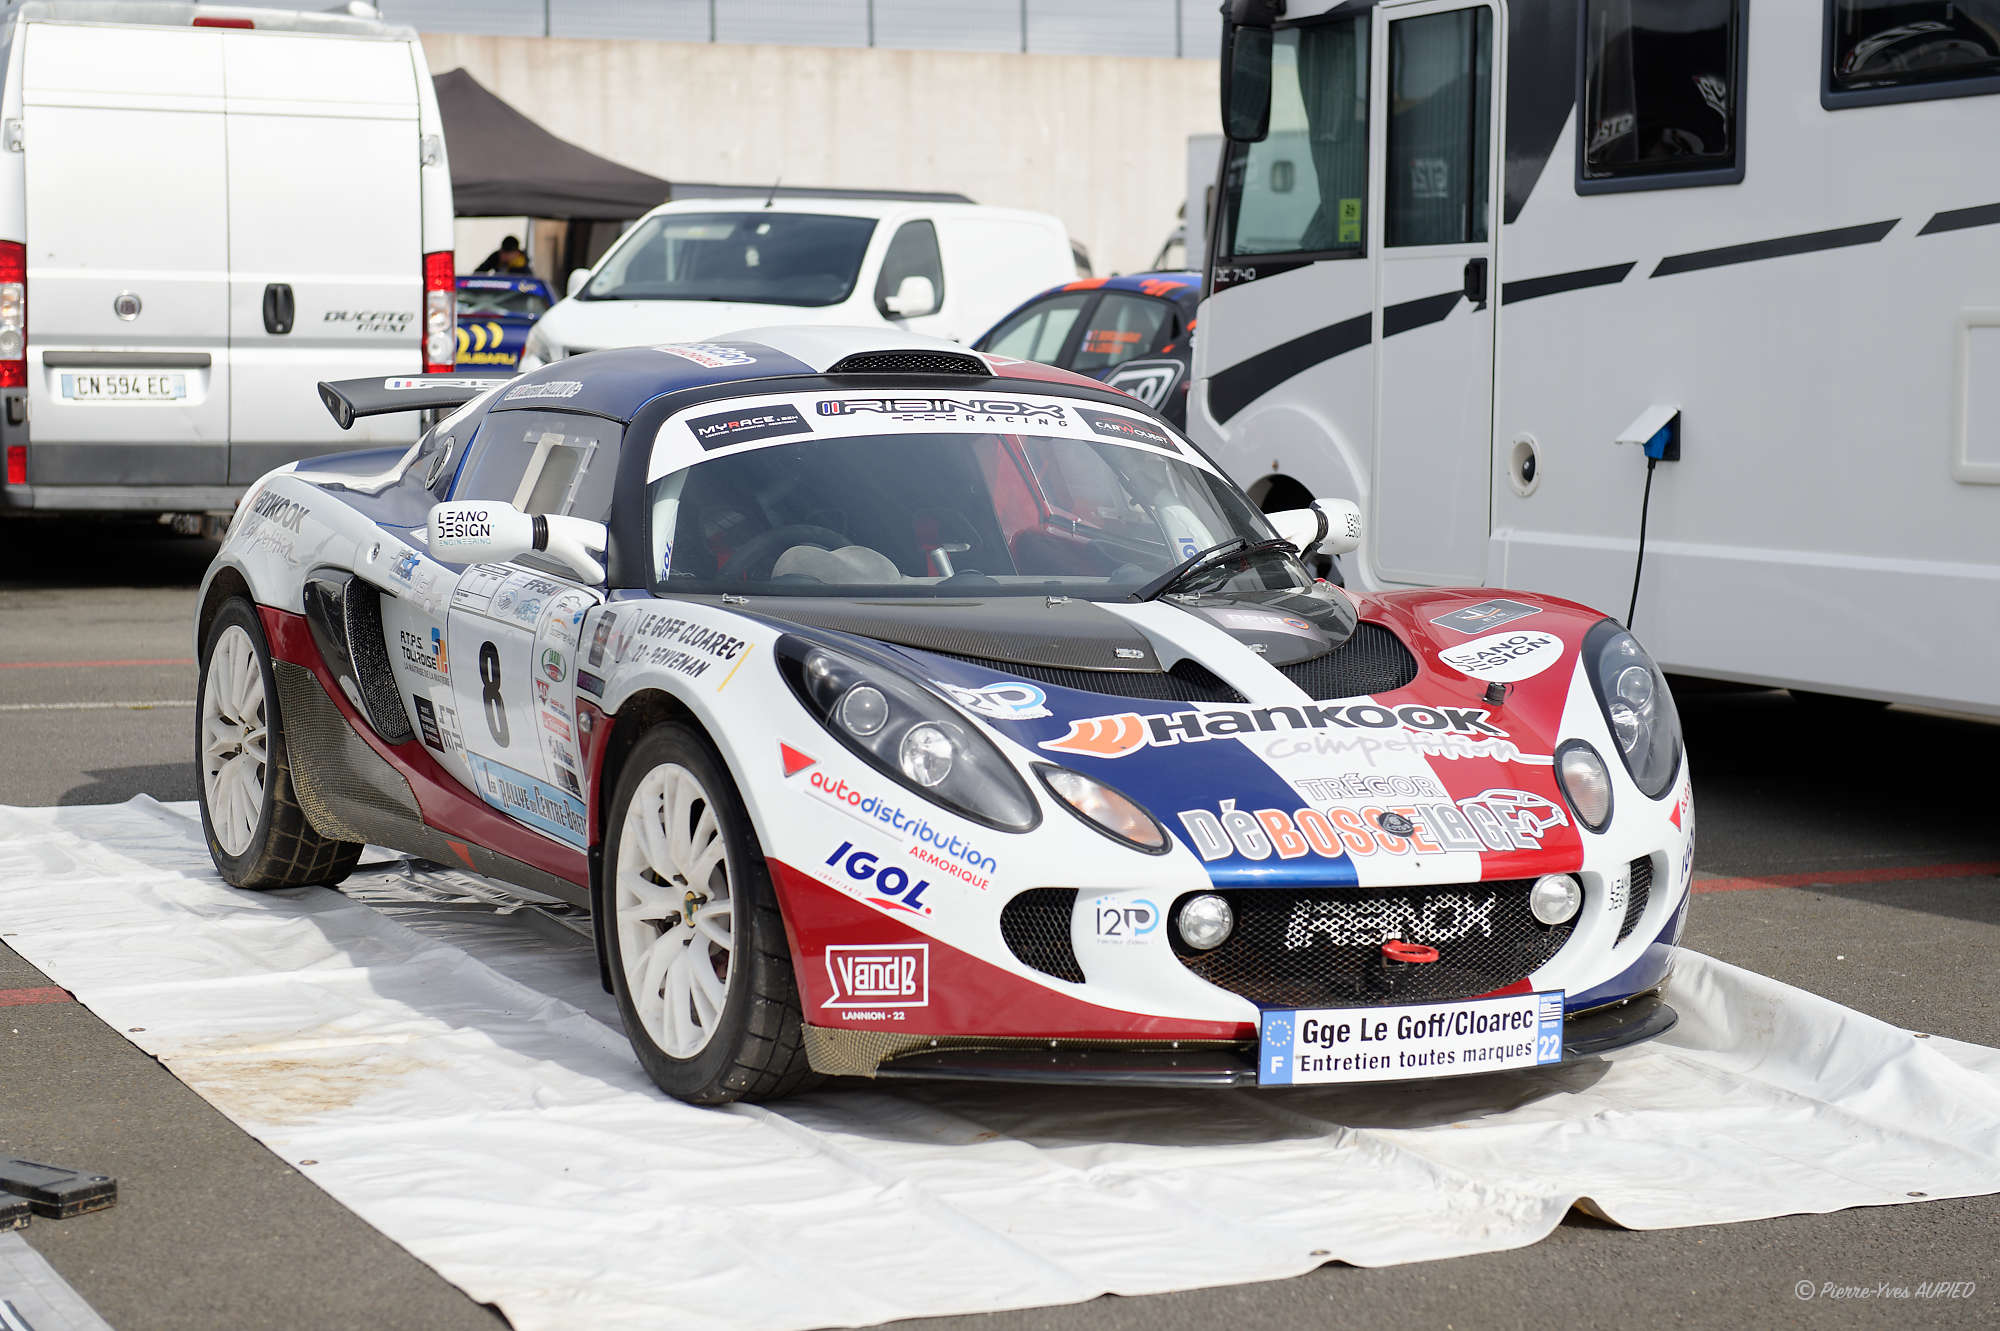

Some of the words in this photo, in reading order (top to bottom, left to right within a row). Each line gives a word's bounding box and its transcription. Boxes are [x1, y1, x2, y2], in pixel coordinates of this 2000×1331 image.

[1231, 268, 1257, 282] 740
[323, 311, 414, 322] DUCATO
[77, 376, 101, 395] CN
[107, 376, 141, 395] 594
[148, 376, 171, 395] EC
[965, 414, 1068, 427] RACING
[438, 511, 488, 525] LEANO
[438, 523, 491, 539] DESIGN
[637, 613, 657, 635] LE
[650, 616, 686, 640] GOFF
[678, 623, 745, 660] CLOAREC
[478, 640, 511, 749] 8
[1297, 772, 1448, 800] TRÉGOR
[810, 771, 997, 875] autodistribution
[909, 845, 990, 891] ARMORIQUE
[841, 1011, 886, 1021] LANNION
[892, 1011, 905, 1021] 22
[1302, 1018, 1351, 1050] Gge
[1360, 1018, 1388, 1043] Le
[1397, 1007, 1534, 1041] Goff/Cloarec
[1300, 1053, 1391, 1073] Entretien
[1399, 1048, 1456, 1068] toutes
[1462, 1041, 1533, 1065] marques
[1538, 1034, 1561, 1061] 22
[1270, 1056, 1284, 1075] F
